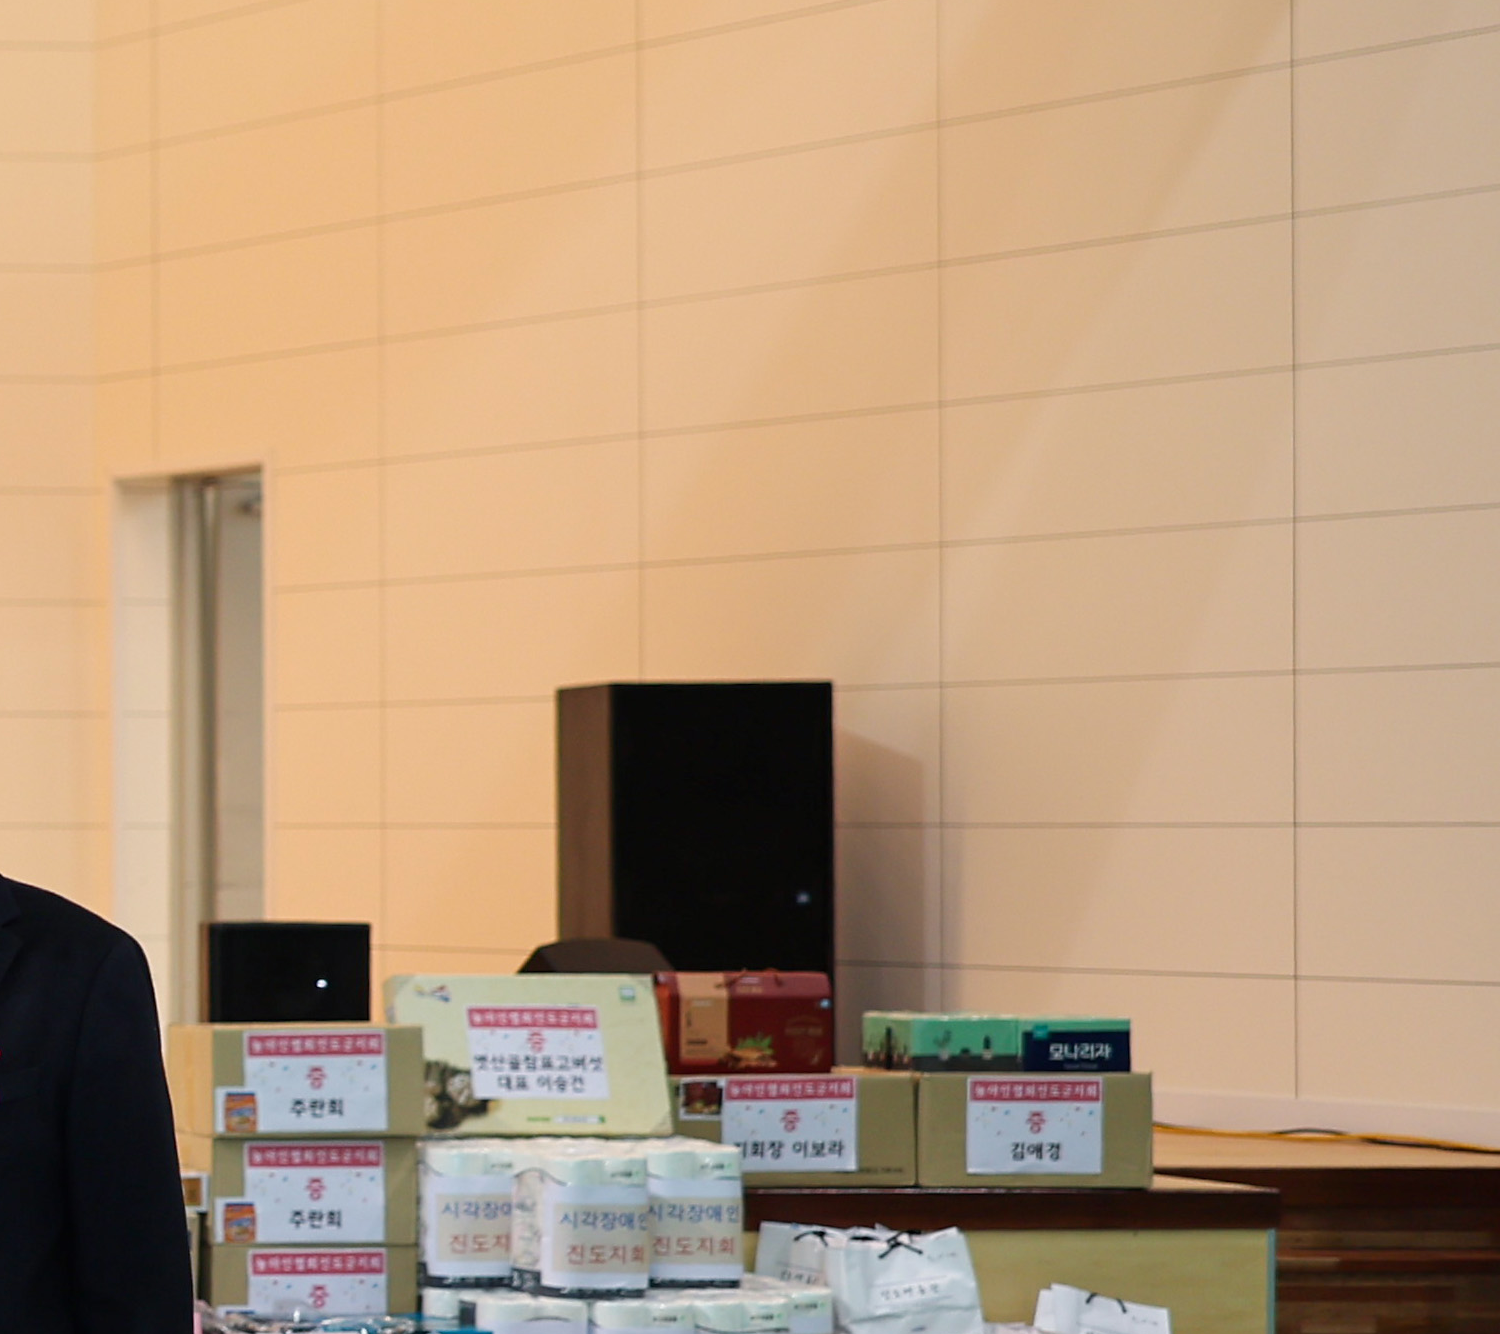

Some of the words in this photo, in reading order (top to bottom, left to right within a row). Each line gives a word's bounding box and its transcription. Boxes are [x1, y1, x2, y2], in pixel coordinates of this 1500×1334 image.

[1048, 1042, 1113, 1061] 모나리자
[497, 1074, 529, 1091] 대표
[1026, 1111, 1046, 1134] 증
[792, 1140, 845, 1158] 이보라
[1010, 1142, 1062, 1162] 김애경
[649, 1203, 739, 1223] 시각장애인
[450, 1233, 512, 1255] 진도지
[651, 1235, 736, 1256] 진도지회
[566, 1244, 646, 1265] 진도지회
